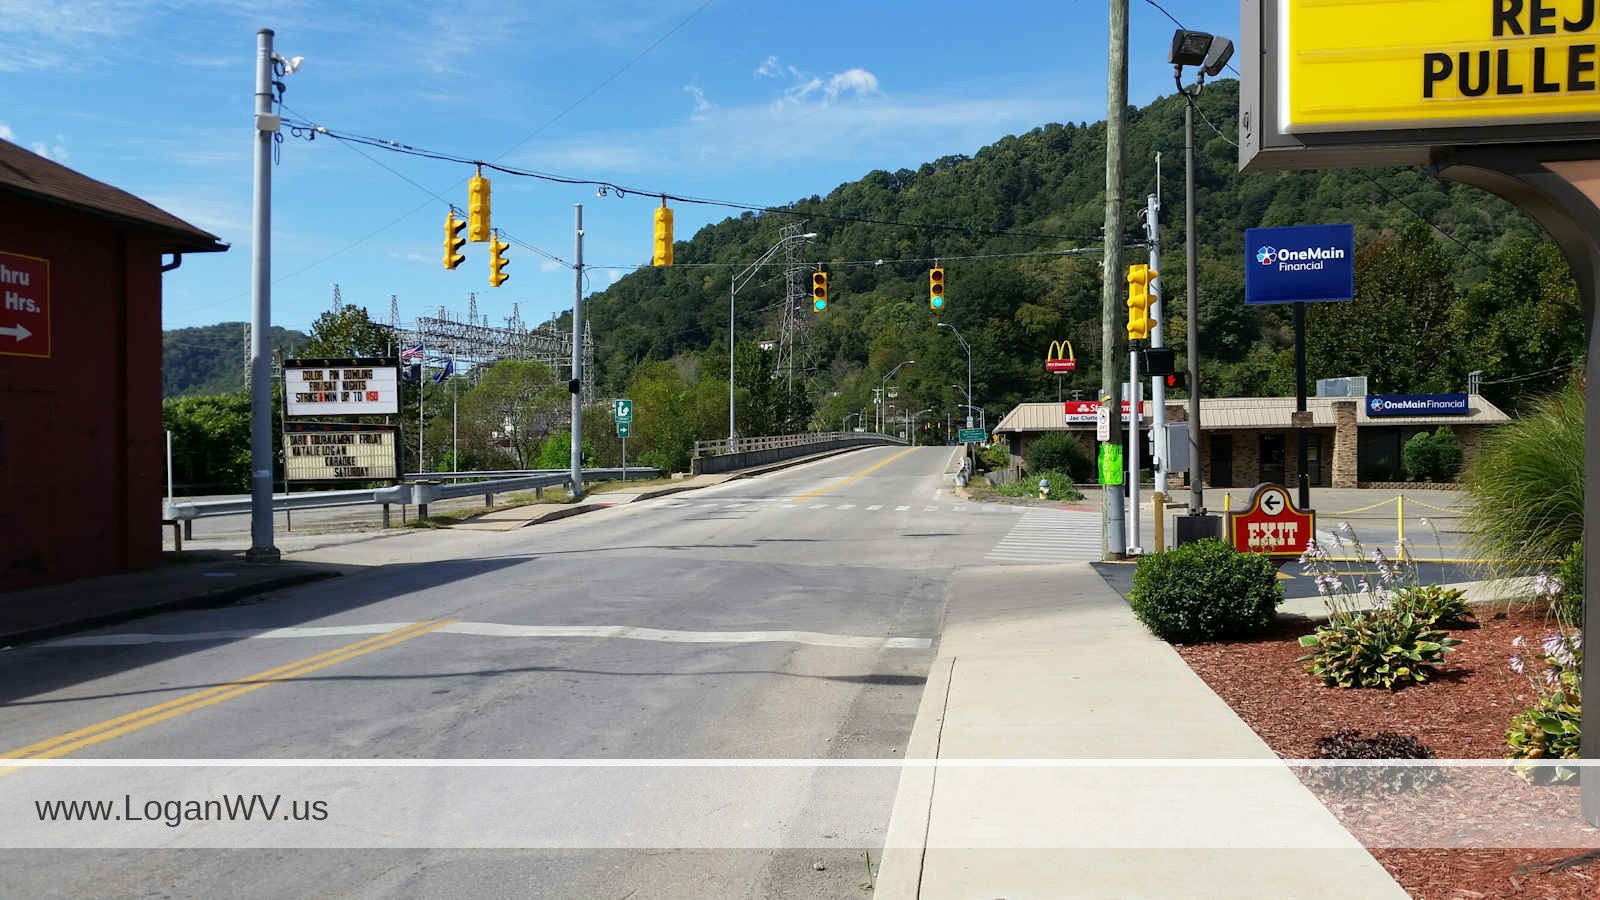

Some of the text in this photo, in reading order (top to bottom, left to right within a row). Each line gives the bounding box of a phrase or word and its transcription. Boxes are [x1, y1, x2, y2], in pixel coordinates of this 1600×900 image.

[1492, 0, 1596, 36] REJ
[1423, 45, 1596, 98] PULLE
[1278, 247, 1344, 261] OneMain
[1279, 261, 1323, 271] Financial
[0, 264, 30, 286] hru
[5, 291, 41, 313] Hrs.
[302, 370, 324, 381] COLOR
[343, 369, 373, 380] BOWLING
[342, 380, 367, 391] NIGHTS
[295, 392, 318, 403] STRIKE
[341, 391, 350, 402] UP
[353, 391, 363, 402] TO
[1384, 400, 1465, 409] OneMain Financial
[359, 433, 382, 445] FRIDAY
[292, 445, 348, 457] NATALIE LOGAN
[324, 455, 356, 467] KARAOKE
[334, 466, 369, 478] SATURDAY
[1247, 522, 1298, 546] EXIT
